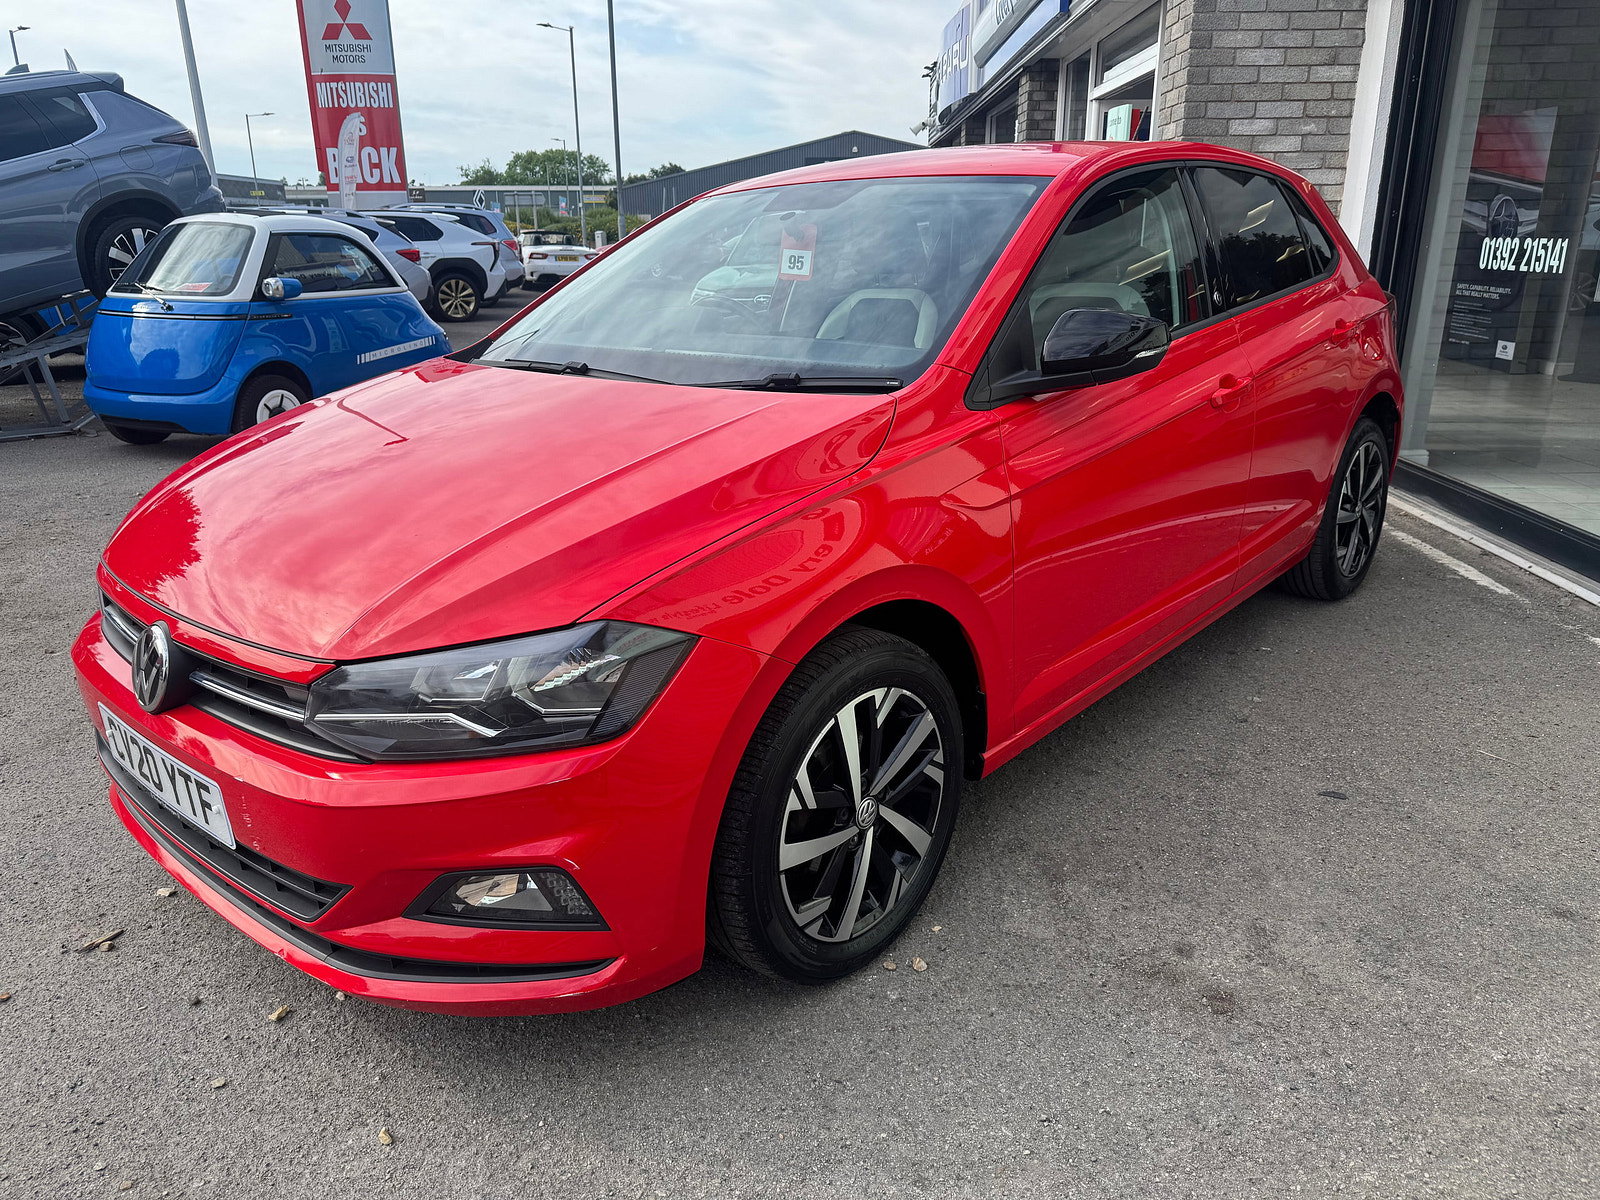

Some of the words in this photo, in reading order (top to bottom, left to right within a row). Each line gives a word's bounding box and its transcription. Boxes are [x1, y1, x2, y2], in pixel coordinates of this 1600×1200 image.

[324, 43, 372, 54] MITSUBISHI
[332, 54, 366, 64] MOTORS
[315, 81, 394, 109] MITSUBISHI
[326, 146, 402, 184] BCK
[788, 254, 804, 271] 95
[1479, 237, 1520, 271] 01392
[1519, 237, 1569, 274] 215141
[107, 715, 165, 794] CV20
[160, 756, 214, 826] YTF
